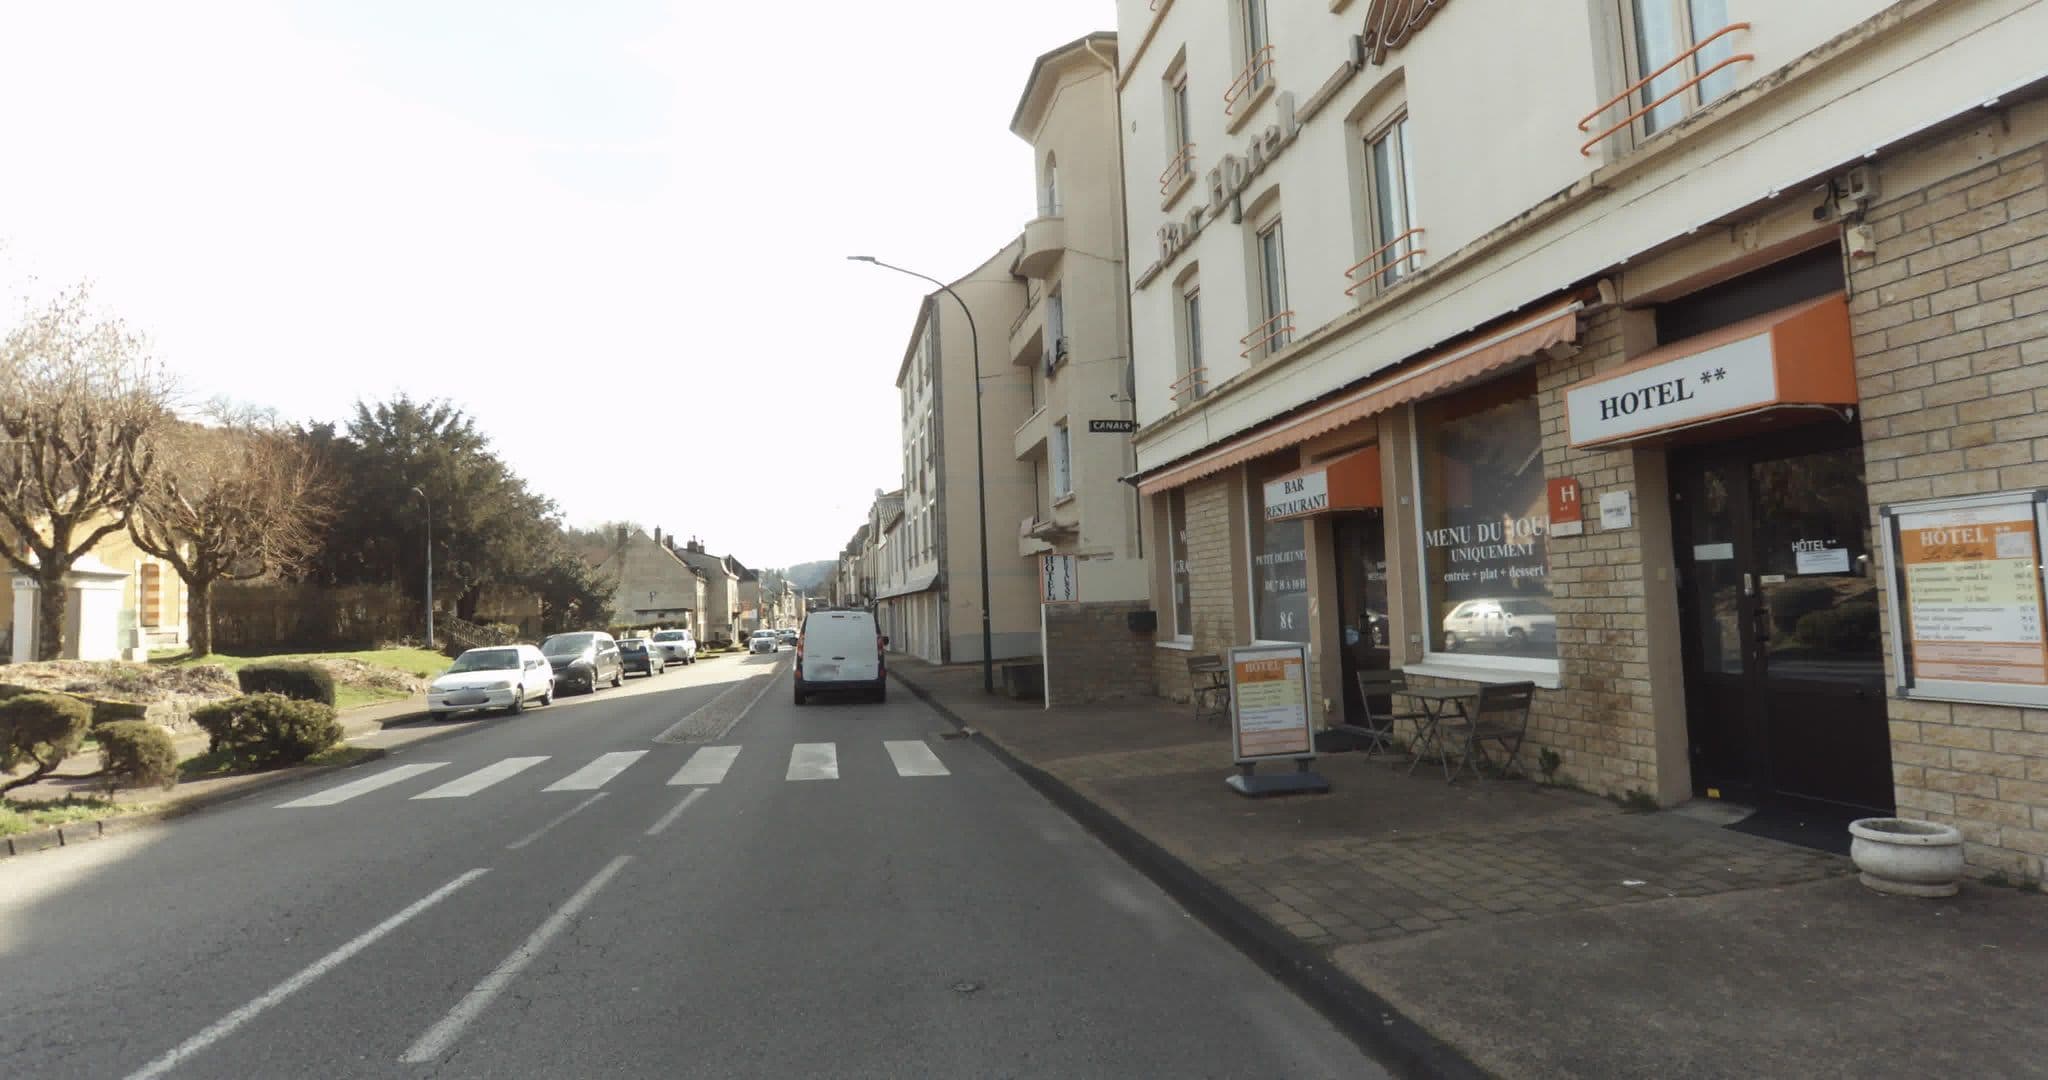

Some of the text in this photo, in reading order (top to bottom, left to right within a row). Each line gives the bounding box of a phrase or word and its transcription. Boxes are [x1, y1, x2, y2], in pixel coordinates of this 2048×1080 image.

[1600, 378, 1694, 420] HOTEL
[1093, 421, 1131, 431] CANAL+
[1284, 478, 1305, 495] BAR
[1561, 484, 1575, 503] H
[1265, 493, 1327, 519] RESTAURANT
[1425, 525, 1471, 548] MENU
[1477, 522, 1502, 543] DU
[1451, 544, 1533, 563] UNIQUEMENT
[1480, 568, 1498, 583] plat
[1509, 566, 1545, 578] dessert
